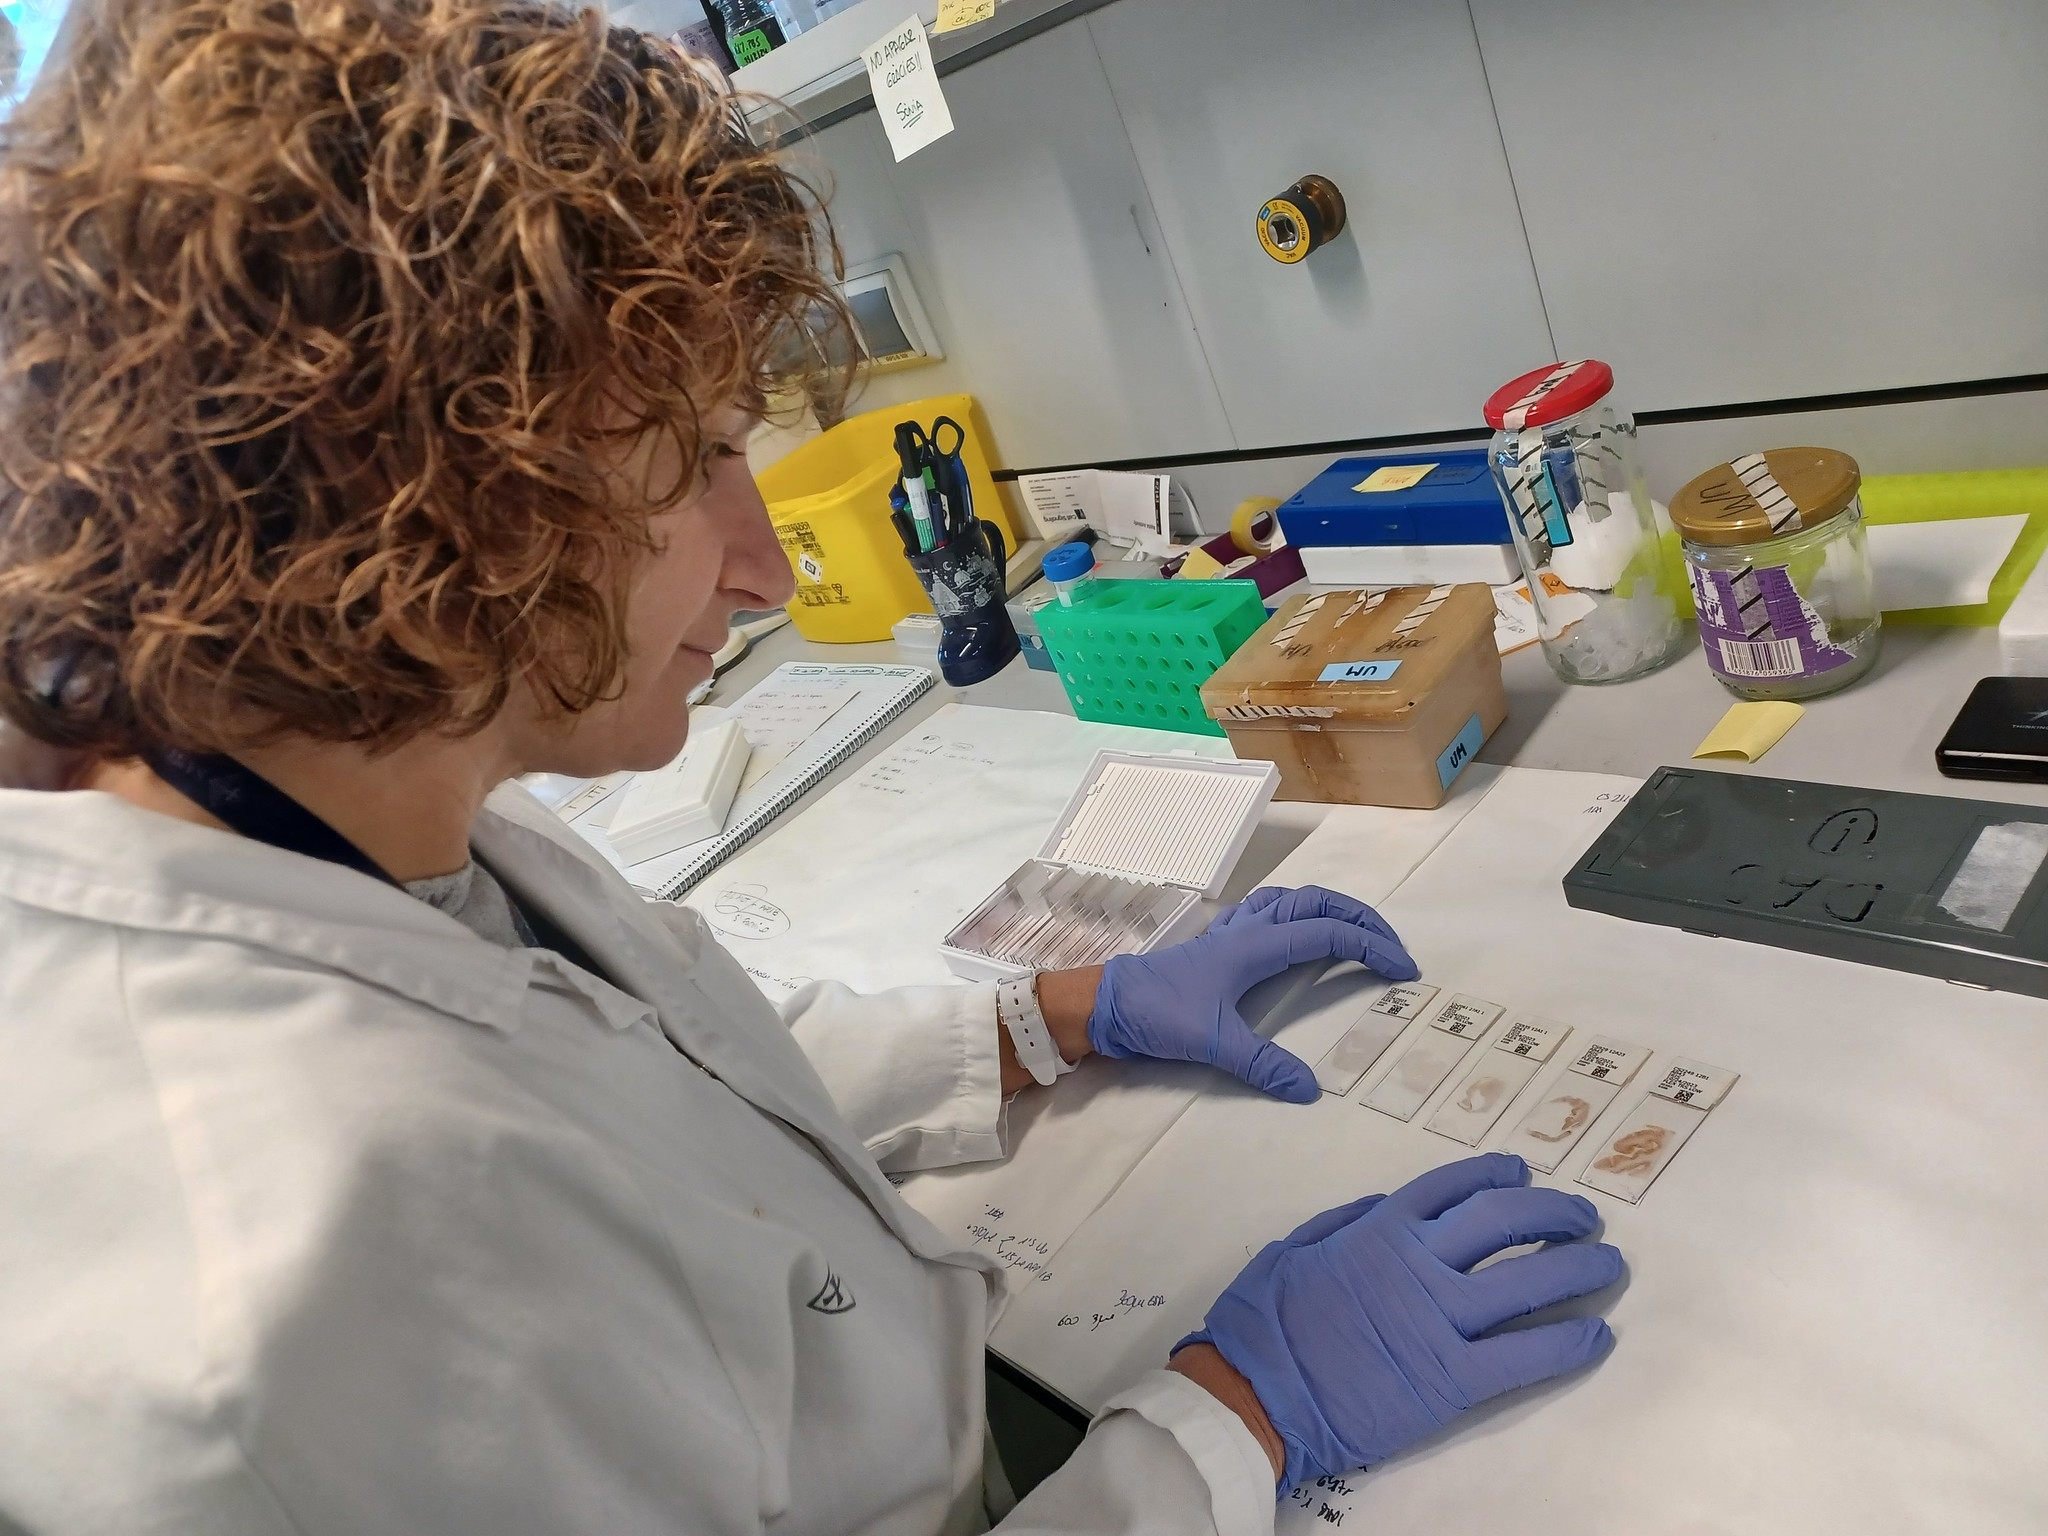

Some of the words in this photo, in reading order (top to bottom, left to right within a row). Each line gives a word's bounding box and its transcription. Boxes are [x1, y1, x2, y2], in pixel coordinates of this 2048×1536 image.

[870, 51, 883, 73] NO
[1295, 214, 1307, 242] VACUUM
[1700, 482, 1757, 519] UM
[1345, 665, 1378, 677] UM
